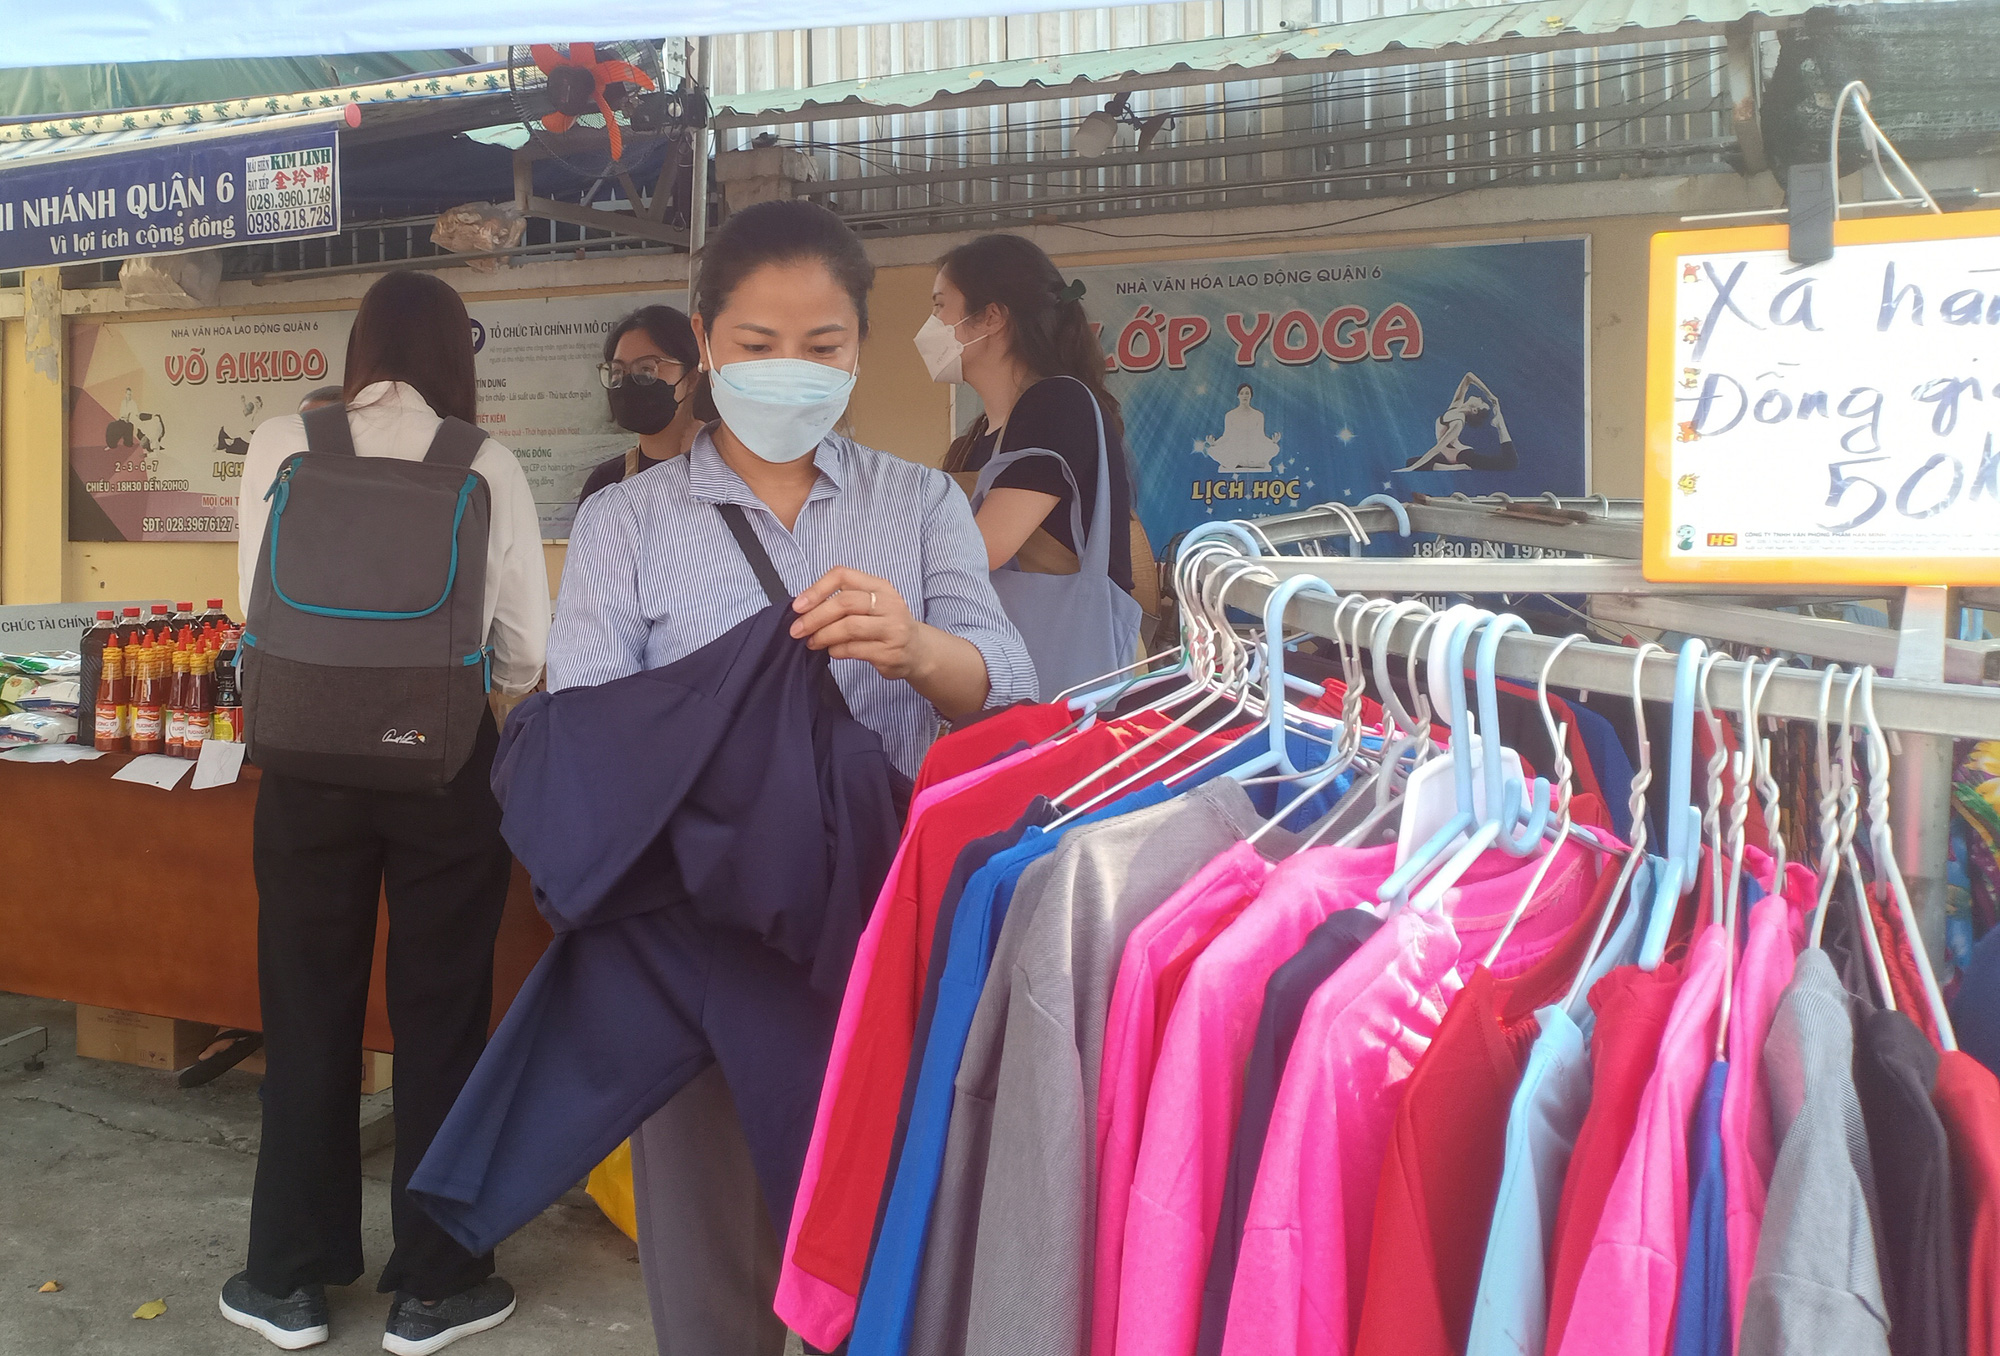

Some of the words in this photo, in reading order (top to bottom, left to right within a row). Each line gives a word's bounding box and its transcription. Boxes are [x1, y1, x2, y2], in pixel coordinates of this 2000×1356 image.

[270, 153, 297, 170] KIM
[299, 148, 331, 167] LINH
[23, 187, 116, 228] NHÁNH
[127, 172, 205, 219] QUẬN
[216, 172, 235, 203] 6
[247, 186, 331, 211] (028).3960.1748
[248, 205, 331, 234] 0938.218.728
[50, 235, 67, 255] Vì
[74, 231, 95, 256] lợi
[102, 228, 129, 248] ích
[136, 223, 185, 248] cộng
[189, 215, 236, 239] đồng
[1116, 280, 1148, 295] NHÀ
[1152, 276, 1186, 293] VĂN
[1190, 273, 1224, 291] HÓA
[1229, 273, 1259, 289] LAO
[1264, 268, 1312, 288] ĐỘNG
[1317, 264, 1368, 283] QUẬN
[1371, 265, 1382, 280] 6
[171, 327, 190, 338] NHÀ
[192, 325, 211, 337] VĂN
[213, 323, 232, 336] HÓA
[234, 324, 251, 335] LAO
[254, 321, 280, 336] ĐỘNG
[283, 320, 311, 334] QUẬN
[313, 321, 319, 331] 6
[490, 321, 501, 338] TỔ
[503, 323, 528, 338] CHỨC
[529, 322, 543, 336] TÀI
[544, 321, 572, 335] CHÍNH
[574, 323, 582, 334] VI
[1224, 302, 1425, 367] YOGA
[164, 347, 209, 386] VÕ
[215, 348, 328, 383] AIKIDO
[476, 377, 486, 388] TÍN
[488, 378, 506, 390] DỤNG
[115, 462, 121, 472] 2
[127, 462, 133, 472] 3
[140, 461, 146, 472] 6
[152, 460, 159, 472] 7
[213, 462, 245, 481] LỊCH
[116, 482, 142, 492] 18H30
[143, 477, 162, 492] ĐẾN
[162, 480, 189, 492] 20H00
[1191, 479, 1245, 505] LỊCH
[1252, 479, 1301, 505] HỌC
[203, 497, 217, 508] MỌI
[219, 497, 233, 506] CHI
[142, 518, 164, 532] SĐT:
[166, 517, 233, 532] 028.39676127
[1709, 534, 1736, 546] HS
[1, 614, 35, 633] CHỨC
[38, 613, 56, 631] TÀI
[58, 613, 94, 629] CHÍNH
